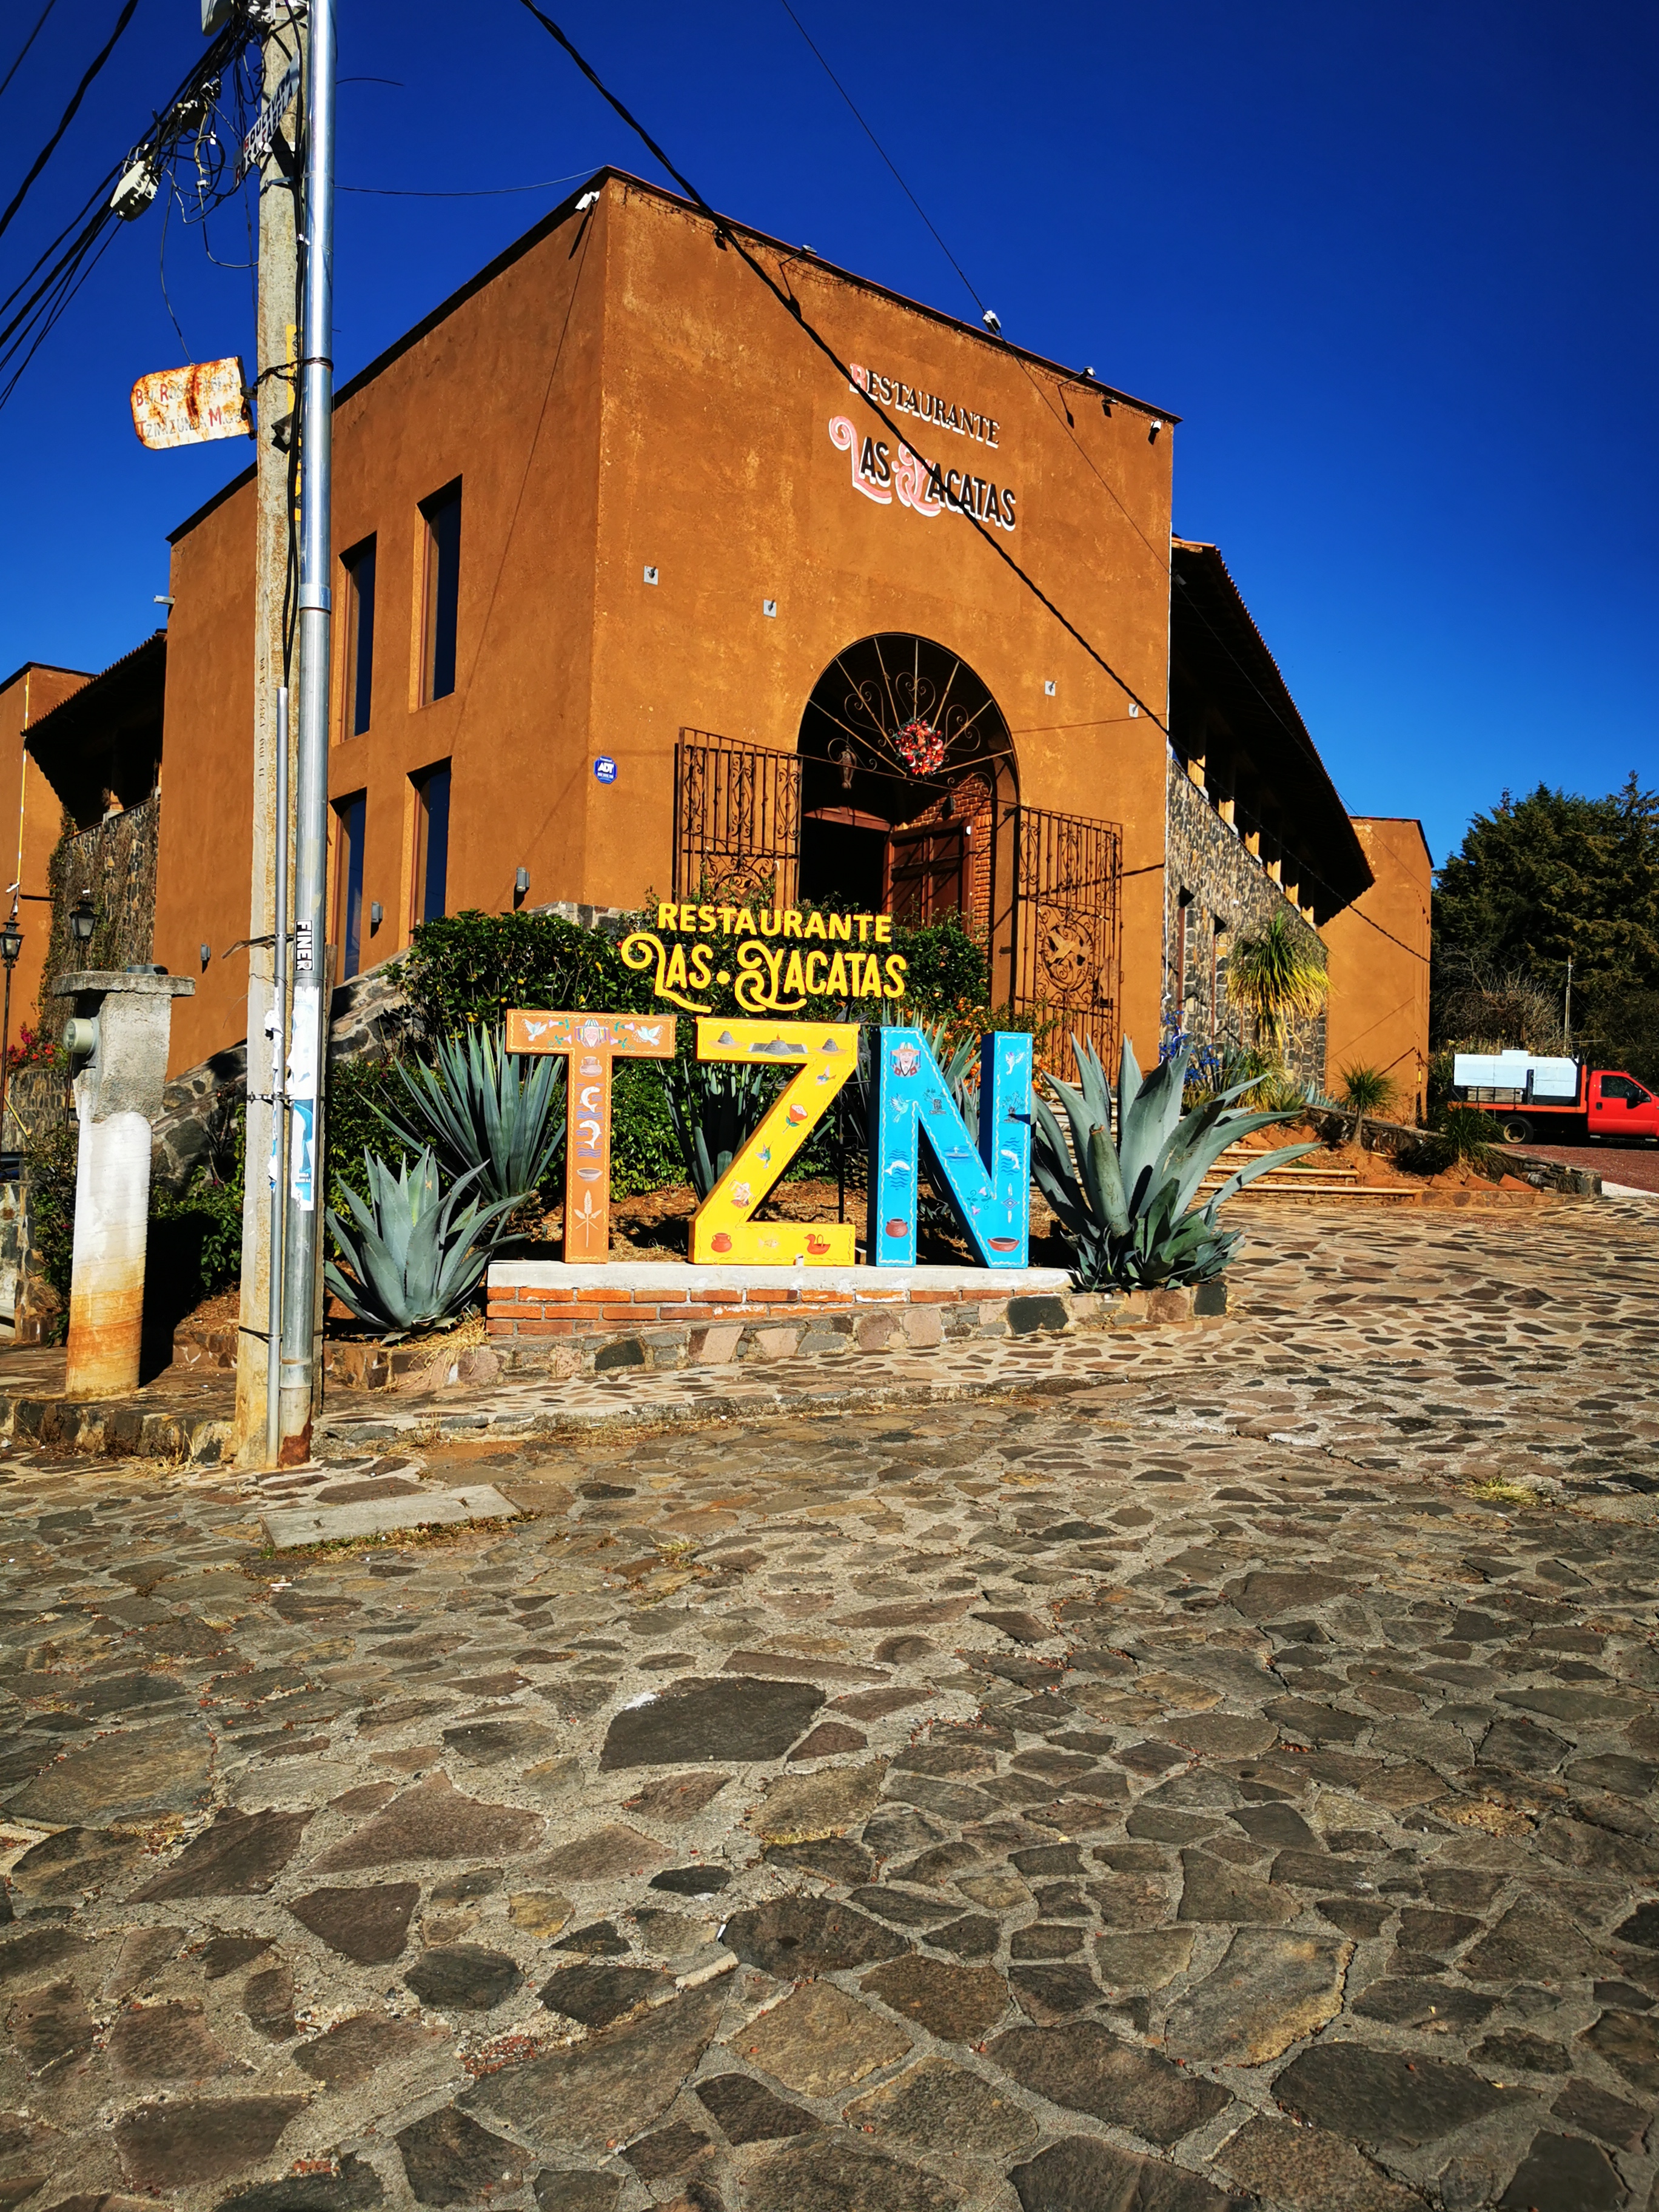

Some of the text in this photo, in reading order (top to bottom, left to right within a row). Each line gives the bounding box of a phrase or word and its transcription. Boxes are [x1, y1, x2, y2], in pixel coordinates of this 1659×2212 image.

[850, 363, 1000, 449] RESTAURANTE
[828, 415, 1016, 532] LAS YACATAS
[597, 762, 614, 774] ADT
[297, 920, 312, 970] FINER
[658, 902, 893, 943] RESTAURANTE
[620, 932, 908, 1014] LAS YACATAS
[506, 1008, 1033, 1269] TZN
